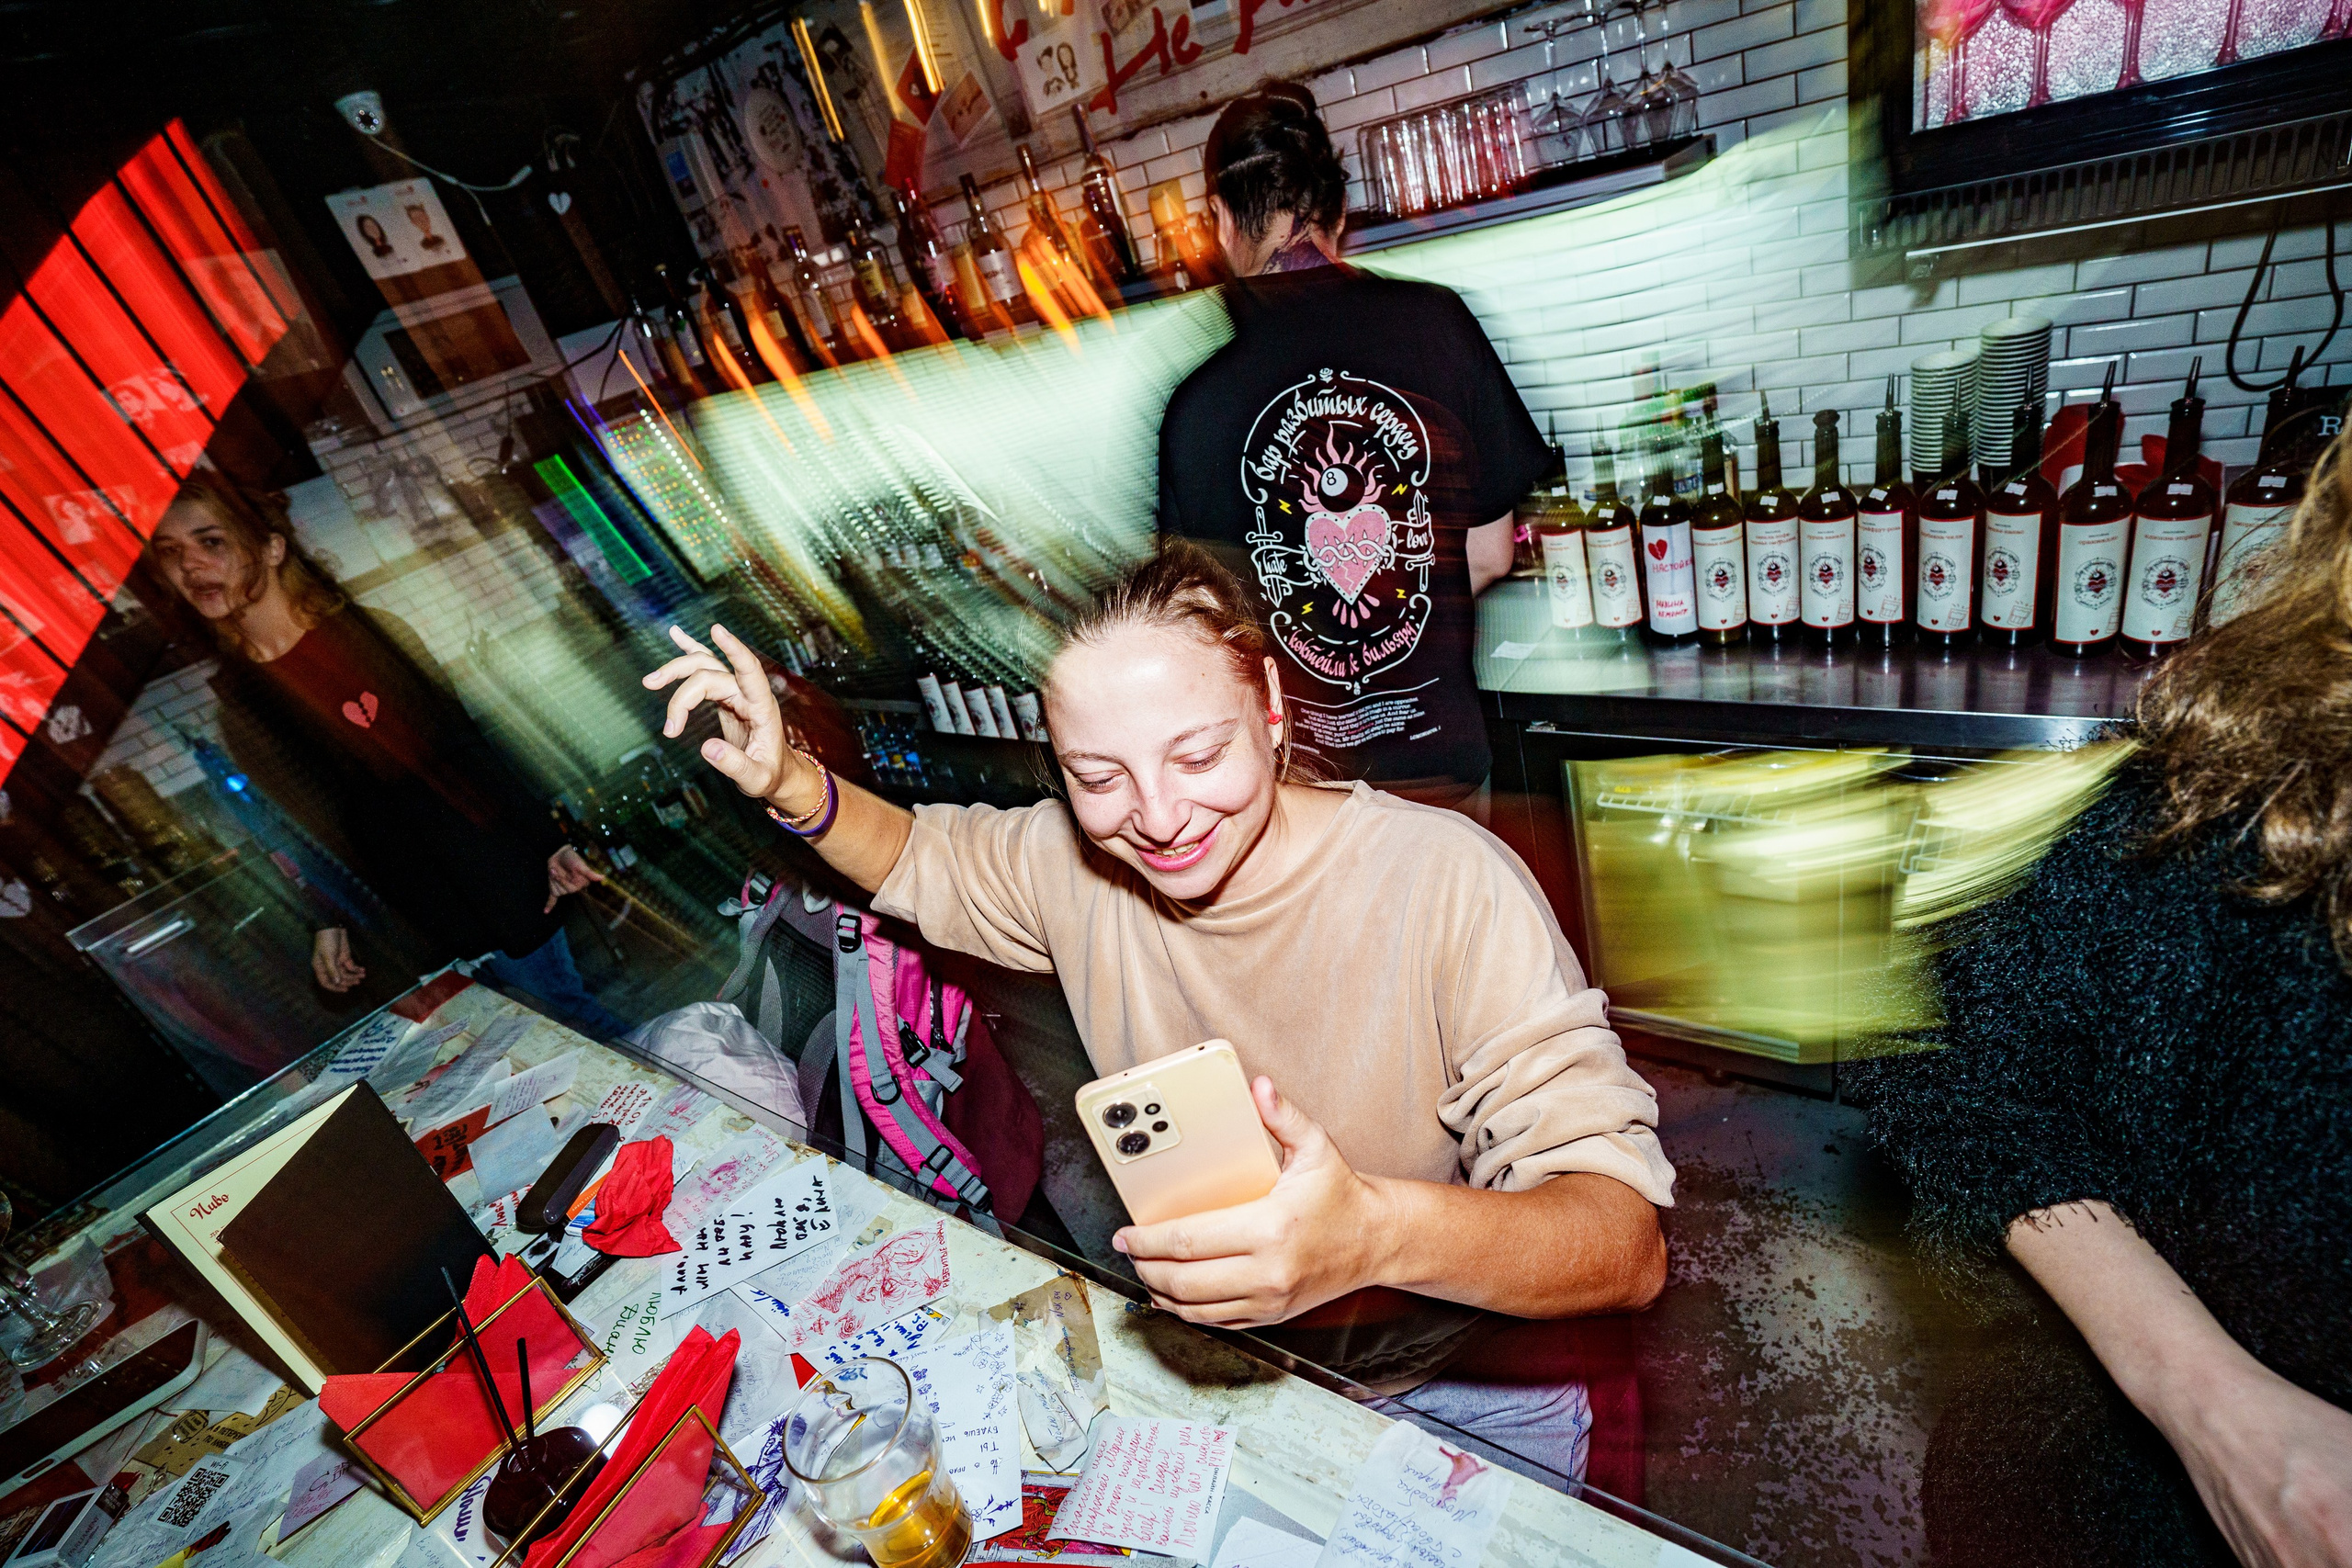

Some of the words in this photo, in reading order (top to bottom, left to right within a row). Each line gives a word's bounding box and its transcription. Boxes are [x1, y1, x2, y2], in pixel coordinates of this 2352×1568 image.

[1273, 388, 1368, 458] разбитых
[1369, 401, 1419, 460] сердец
[1326, 471, 1337, 486] 8
[1262, 551, 1288, 574] hate
[1288, 629, 1346, 677] коктейли
[1363, 621, 1418, 667] бильярд
[964, 1426, 999, 1437] БУДЕШЬ
[979, 1441, 999, 1452] ТЫ
[1063, 1477, 1094, 1536] Спасибо
[1092, 1439, 1108, 1470] моей
